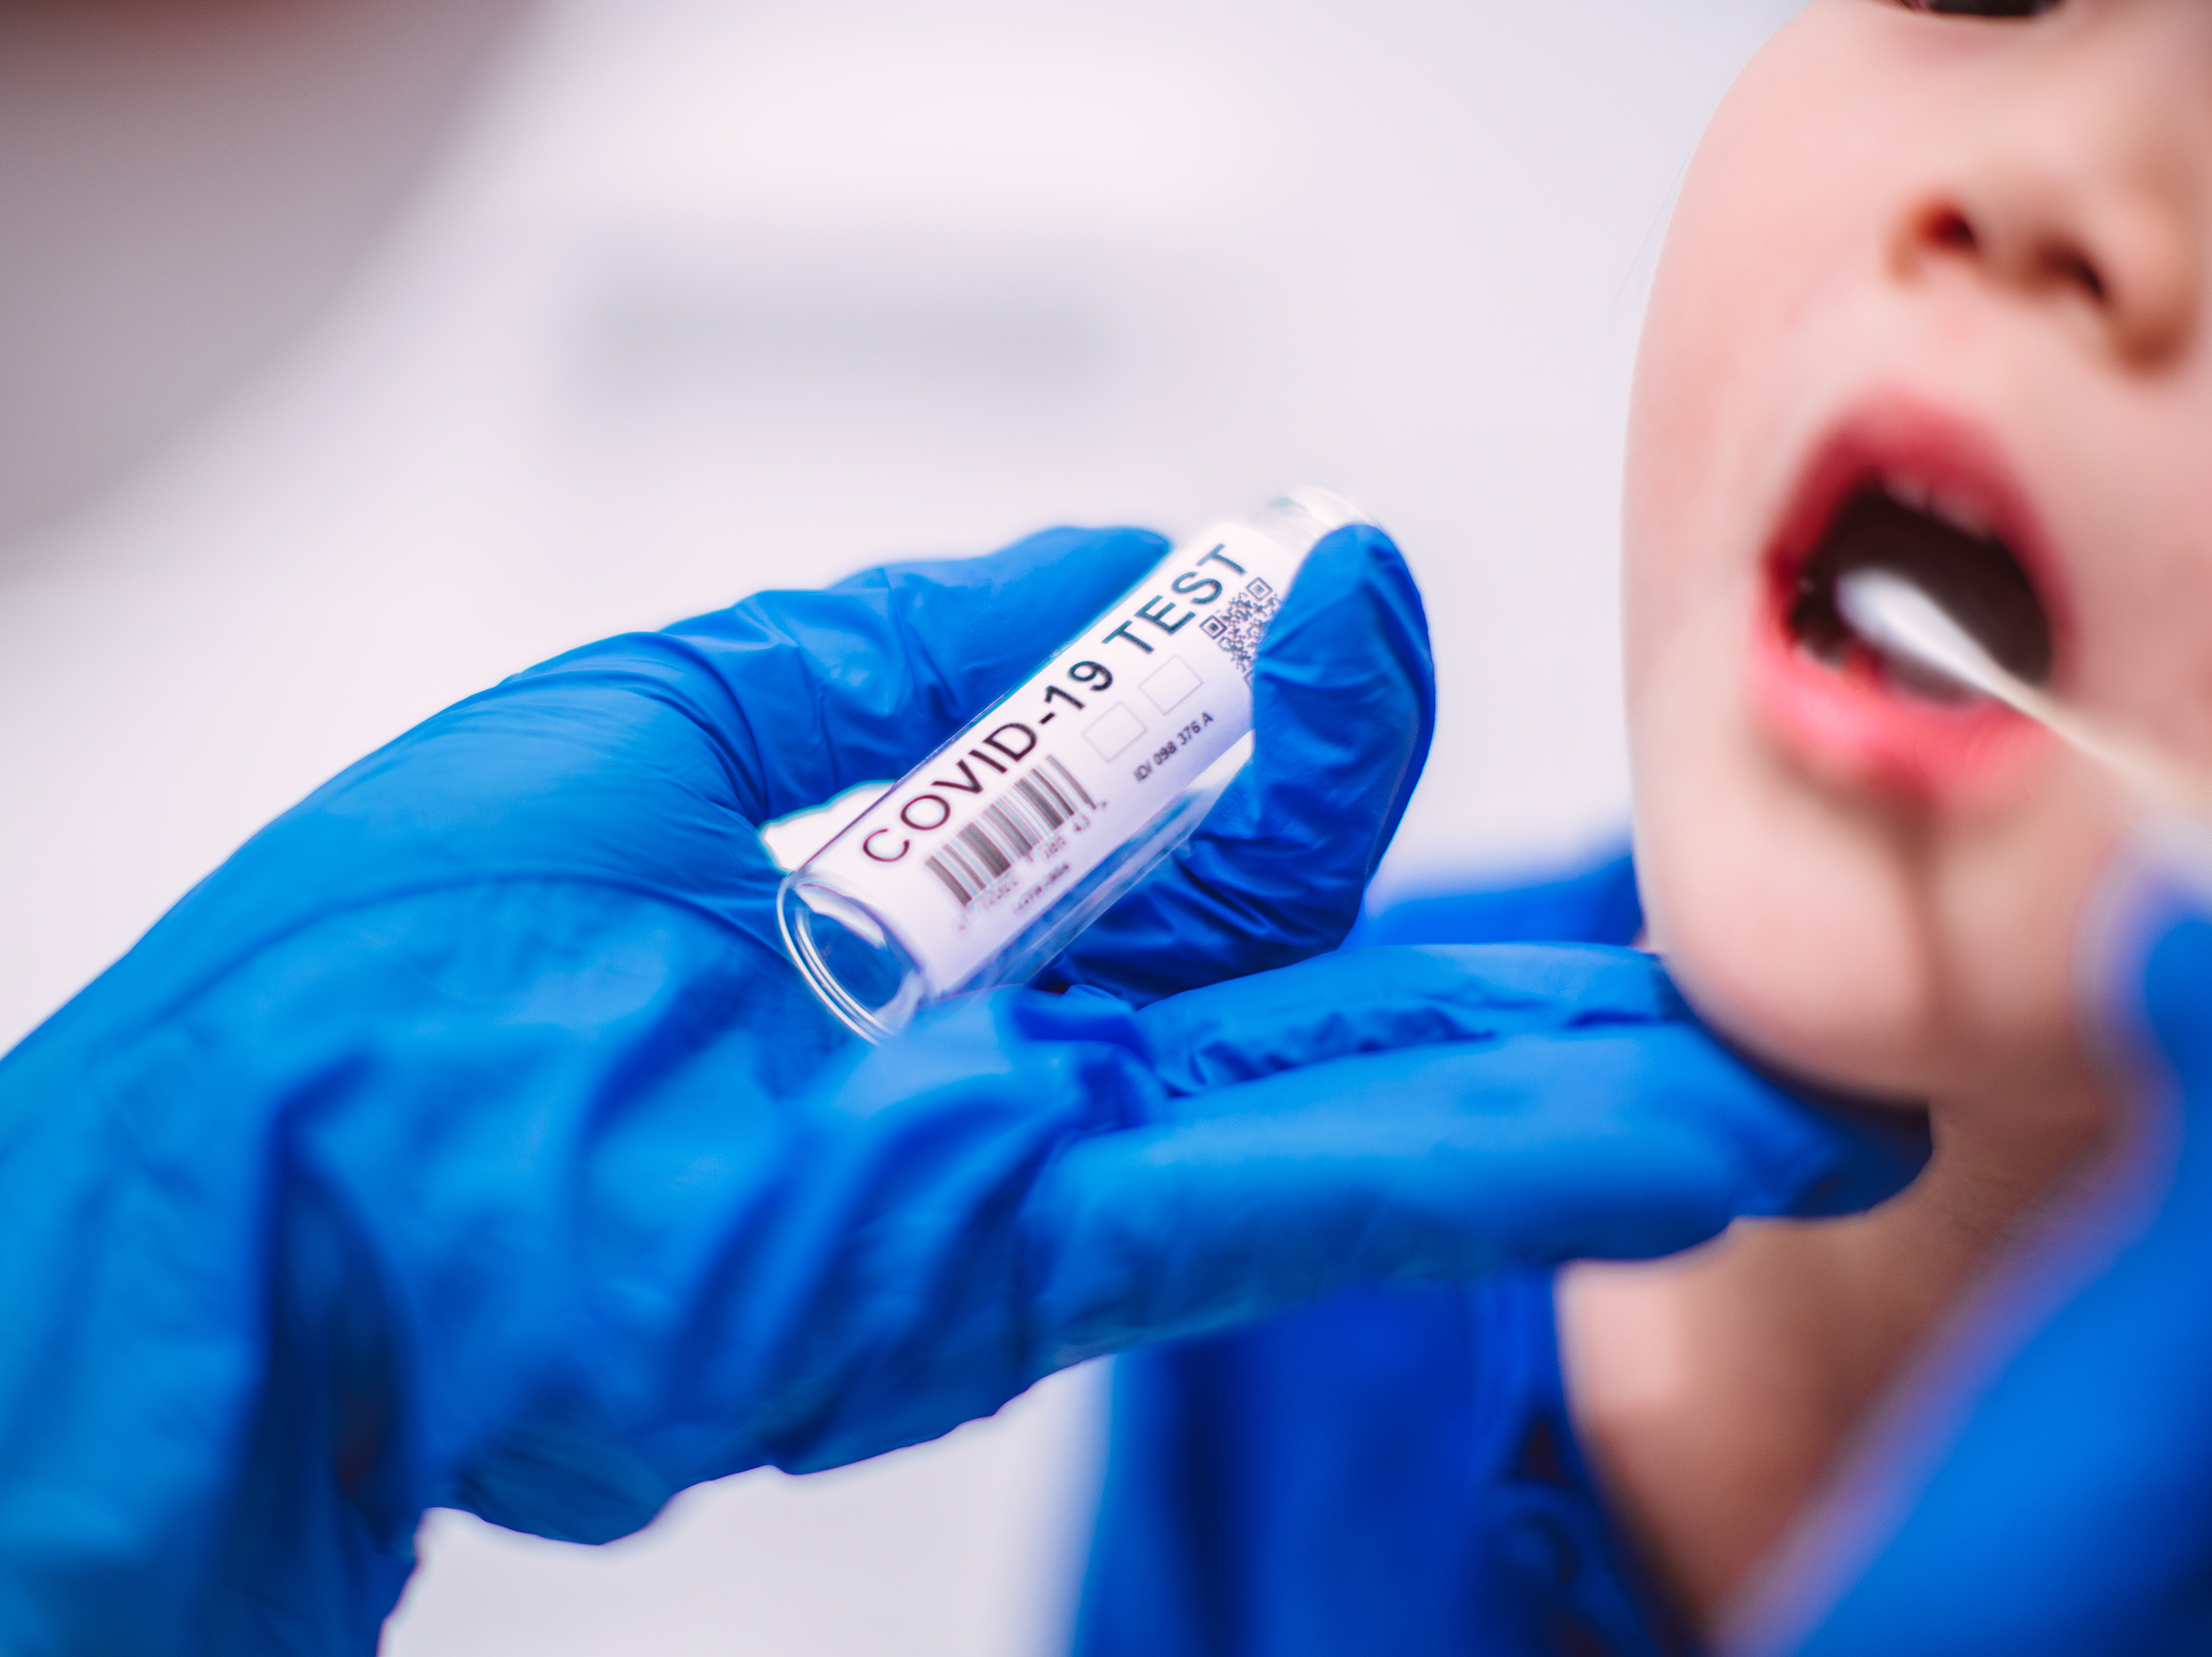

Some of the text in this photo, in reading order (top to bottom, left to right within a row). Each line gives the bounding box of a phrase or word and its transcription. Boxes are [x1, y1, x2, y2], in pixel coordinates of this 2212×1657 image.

[862, 543, 1248, 863] COVID-19 TEST
[1153, 740, 1177, 765] 098
[1177, 720, 1202, 745] 376
[1202, 711, 1215, 727] A
